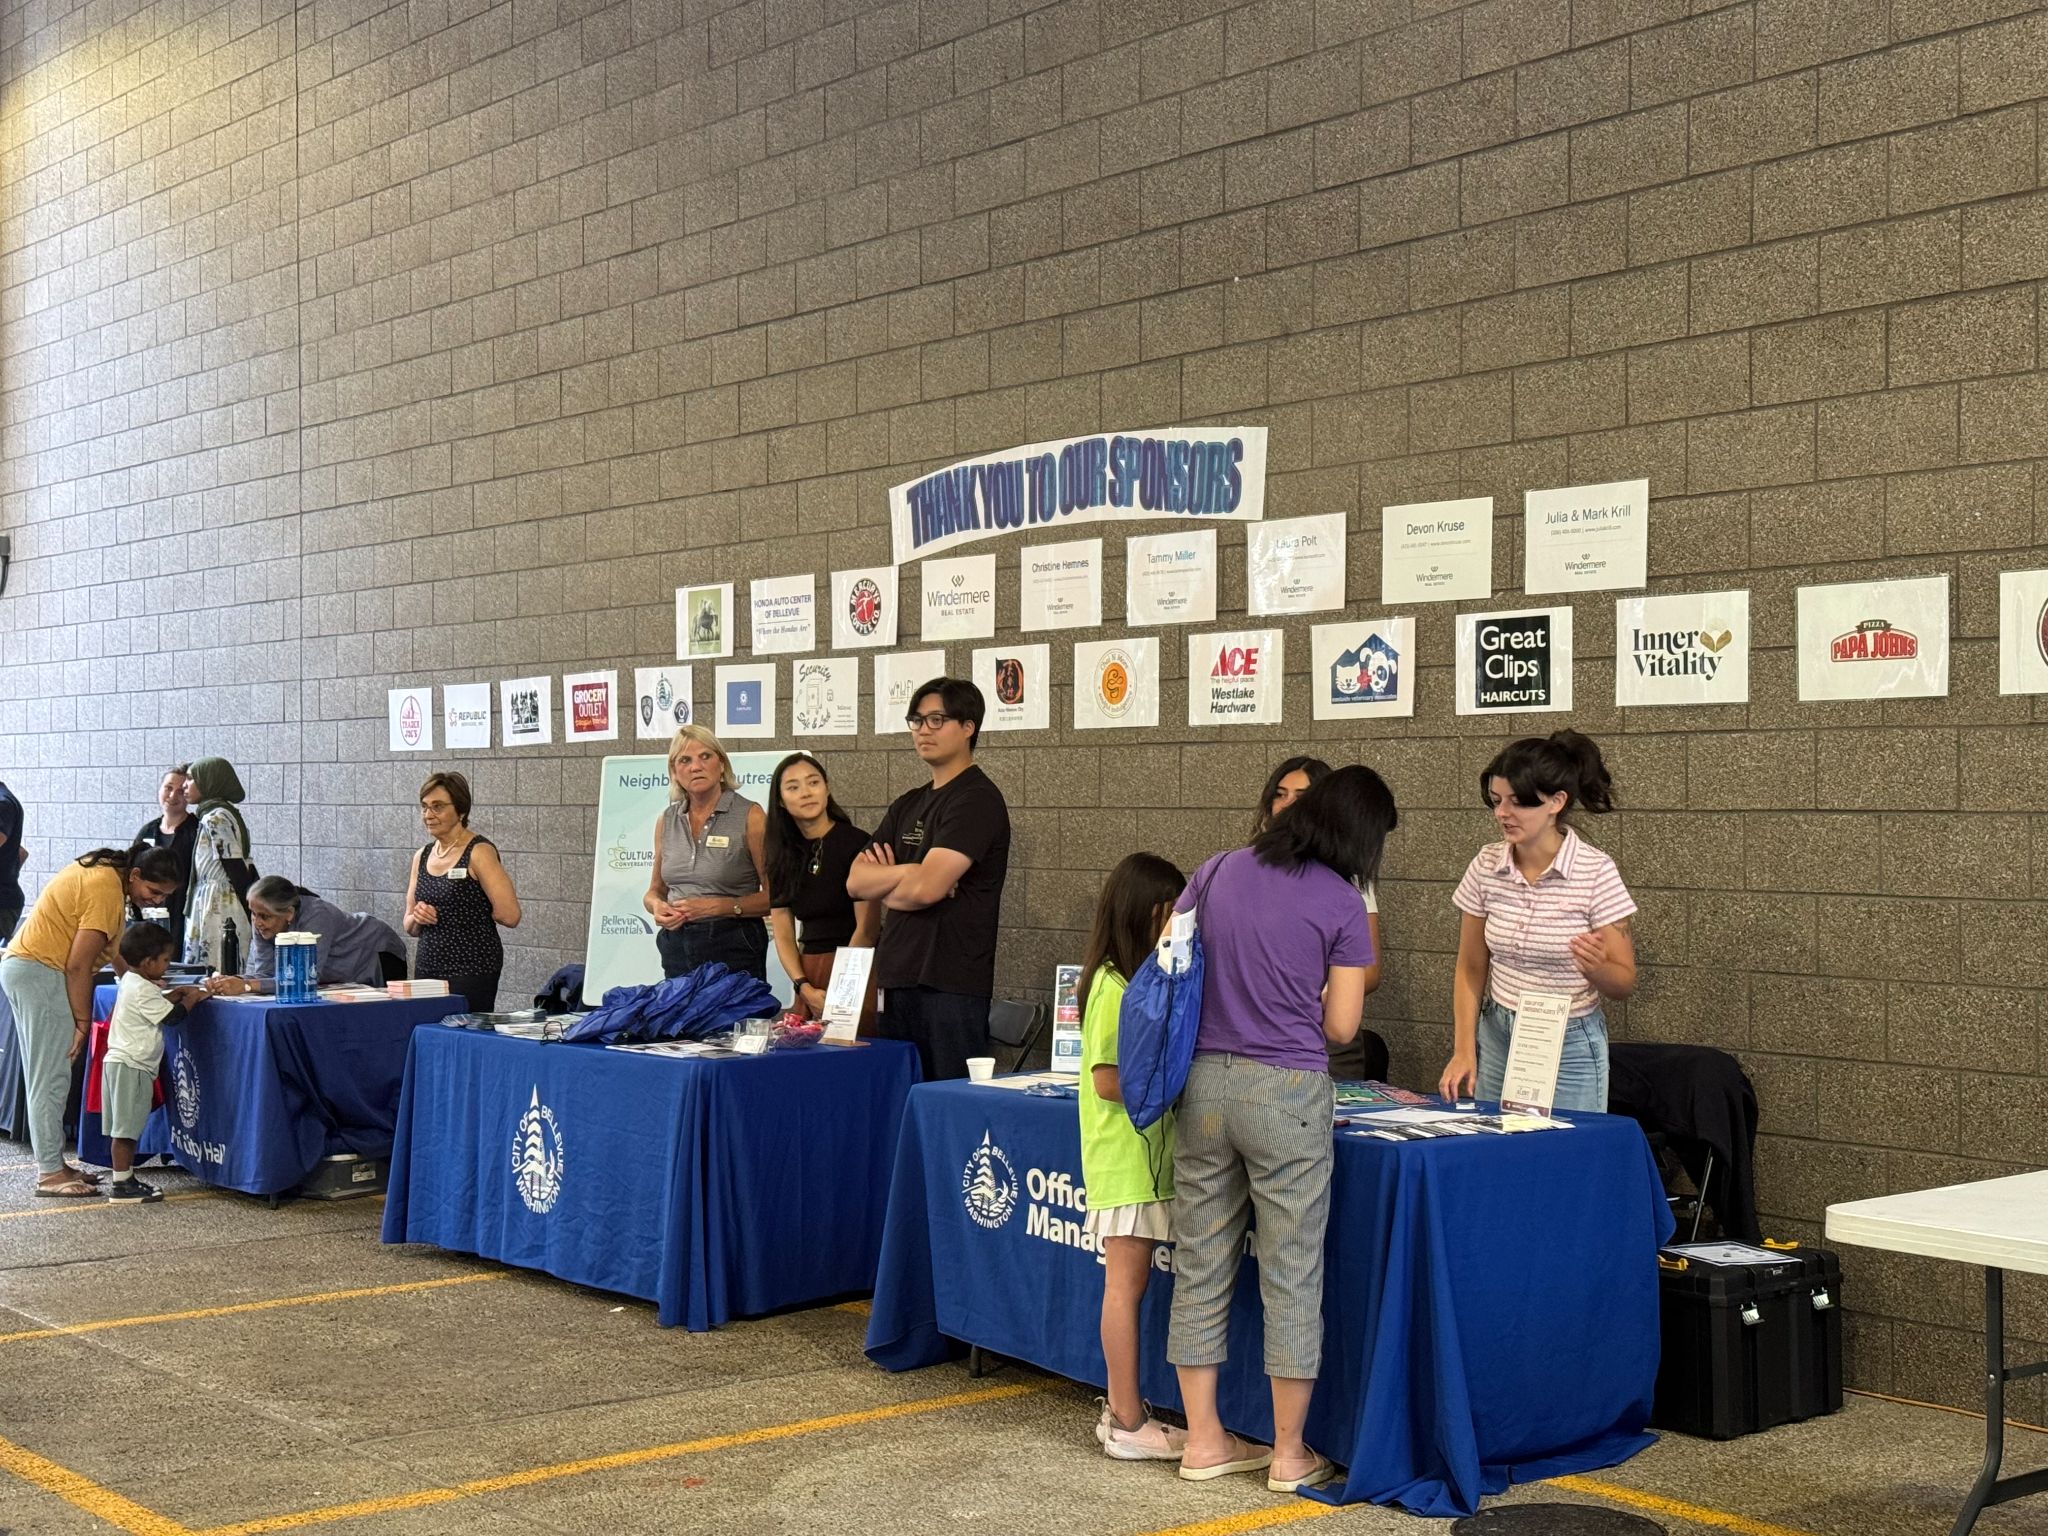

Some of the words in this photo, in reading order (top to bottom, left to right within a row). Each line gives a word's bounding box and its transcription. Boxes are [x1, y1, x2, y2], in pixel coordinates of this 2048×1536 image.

[907, 465, 980, 549] THANK
[977, 459, 1025, 529] YOU
[1025, 452, 1057, 524] TO
[1059, 438, 1107, 516] OUR
[1109, 435, 1243, 515] SPONSORS
[1545, 511, 1568, 525] Julia
[1571, 509, 1580, 522] &
[1582, 507, 1608, 520] Mark
[1611, 504, 1631, 518] Krill
[1406, 523, 1434, 536] Devon
[1437, 521, 1465, 533] Kruse
[1147, 552, 1174, 565] Tammy
[1175, 550, 1197, 561] Miller
[1564, 560, 1607, 571] Windermere
[1031, 562, 1061, 573] Christine
[774, 597, 789, 606] AUTO
[790, 594, 811, 604] CENTER
[927, 589, 990, 607] Windermere
[773, 608, 800, 618] BELLEVUE
[941, 609, 954, 617] REAL
[955, 608, 975, 616] ESTATE
[1863, 620, 1885, 629] PIZZA
[1480, 625, 1546, 651] Great
[1632, 628, 1699, 655] Inner
[1833, 633, 1868, 659] PAPA
[1870, 632, 1915, 658] JOHNS
[1210, 643, 1259, 677] ACE
[1632, 652, 1723, 681] Vitality
[799, 663, 832, 683] Security
[1485, 655, 1538, 685] Clips
[574, 688, 607, 704] GROCERY
[1211, 686, 1255, 700] Westlake
[1480, 689, 1546, 703] HAIRCUTS
[579, 702, 603, 717] OUTLET
[1210, 701, 1256, 713] Hardware
[458, 711, 487, 720] REPUBLIC
[619, 773, 670, 790] Neighb
[620, 851, 655, 860] CULTUR
[602, 915, 638, 926] Bellevue
[601, 925, 643, 935] Essentials
[512, 1131, 523, 1168] CITY
[541, 1105, 563, 1174] BELLEVUE
[962, 1160, 974, 1187] CITY
[991, 1146, 1018, 1198] BELLEVUE
[516, 1175, 560, 1214] WASHINGTON
[1026, 1168, 1086, 1213] Offic
[964, 1195, 1013, 1229] WASHINGTON
